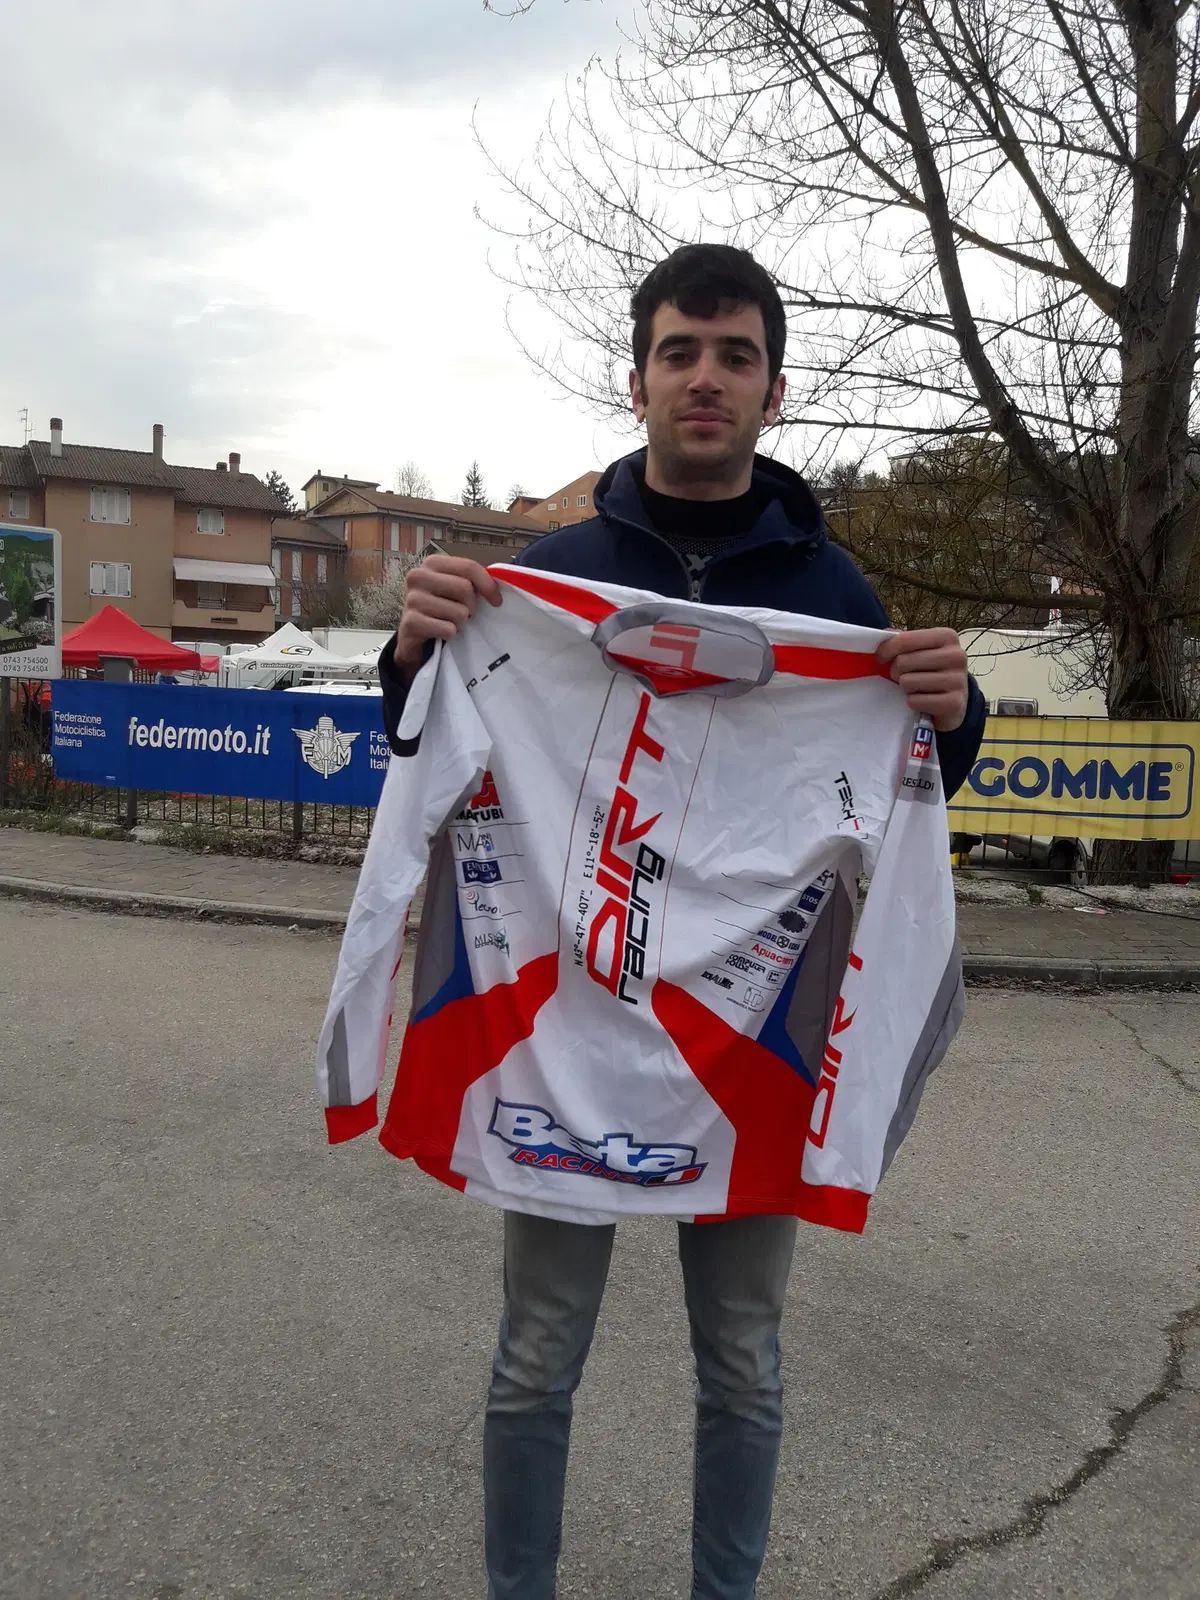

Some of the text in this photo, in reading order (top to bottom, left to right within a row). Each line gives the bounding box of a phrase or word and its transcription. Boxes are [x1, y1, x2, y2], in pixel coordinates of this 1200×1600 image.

[3, 656, 49, 664] 0743 754500
[54, 710, 102, 725] Federazione
[54, 723, 107, 738] Motociclistica
[128, 716, 271, 756] federmoto.it
[54, 735, 83, 748] Italiana
[618, 842, 666, 1006] racing
